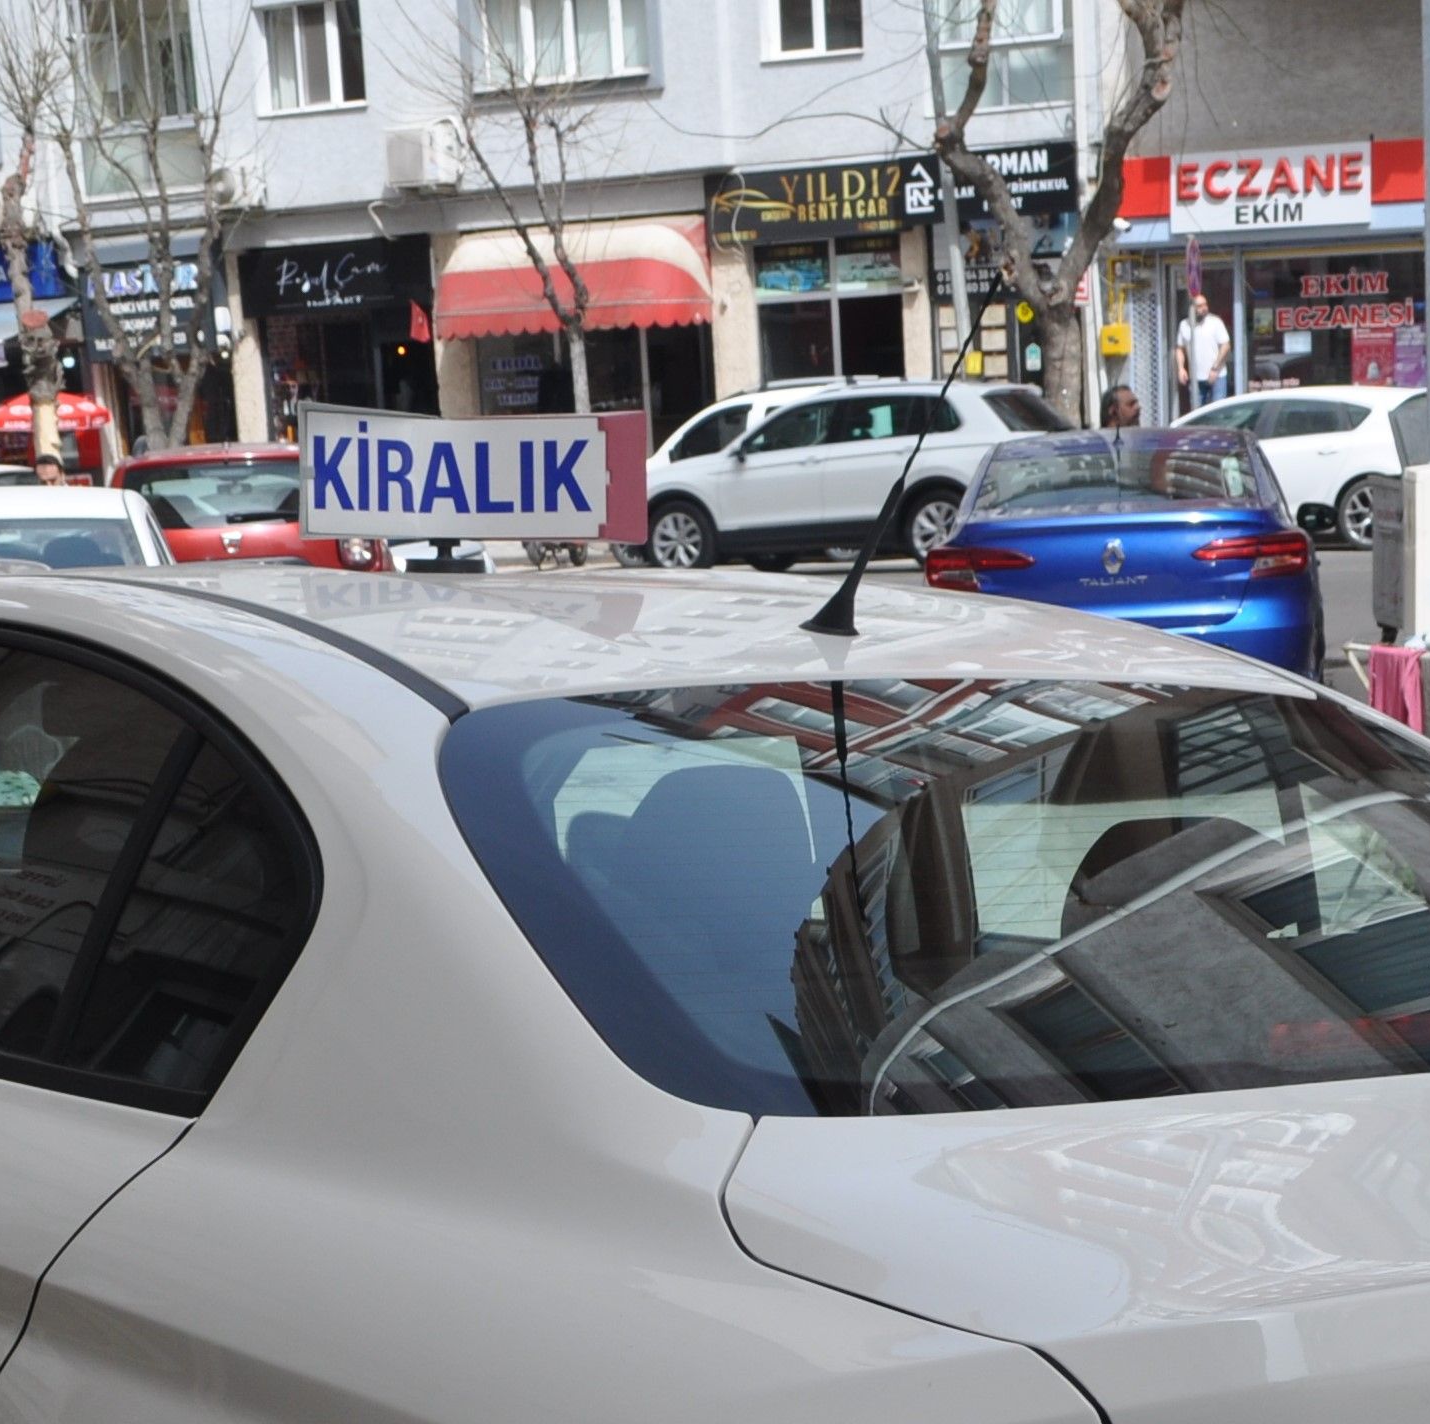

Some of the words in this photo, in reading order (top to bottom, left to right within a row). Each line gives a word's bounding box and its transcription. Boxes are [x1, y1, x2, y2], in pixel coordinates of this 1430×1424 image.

[1176, 151, 1364, 201] ECZANE
[798, 202, 838, 222] RENT
[843, 202, 853, 219] A
[856, 198, 888, 218] CAR
[1235, 199, 1303, 225] EKİM
[1300, 266, 1389, 299] EKİM
[1276, 297, 1414, 331] ECZANESİ
[312, 420, 593, 515] KİRALIK
[1079, 574, 1148, 587] TALIANT
